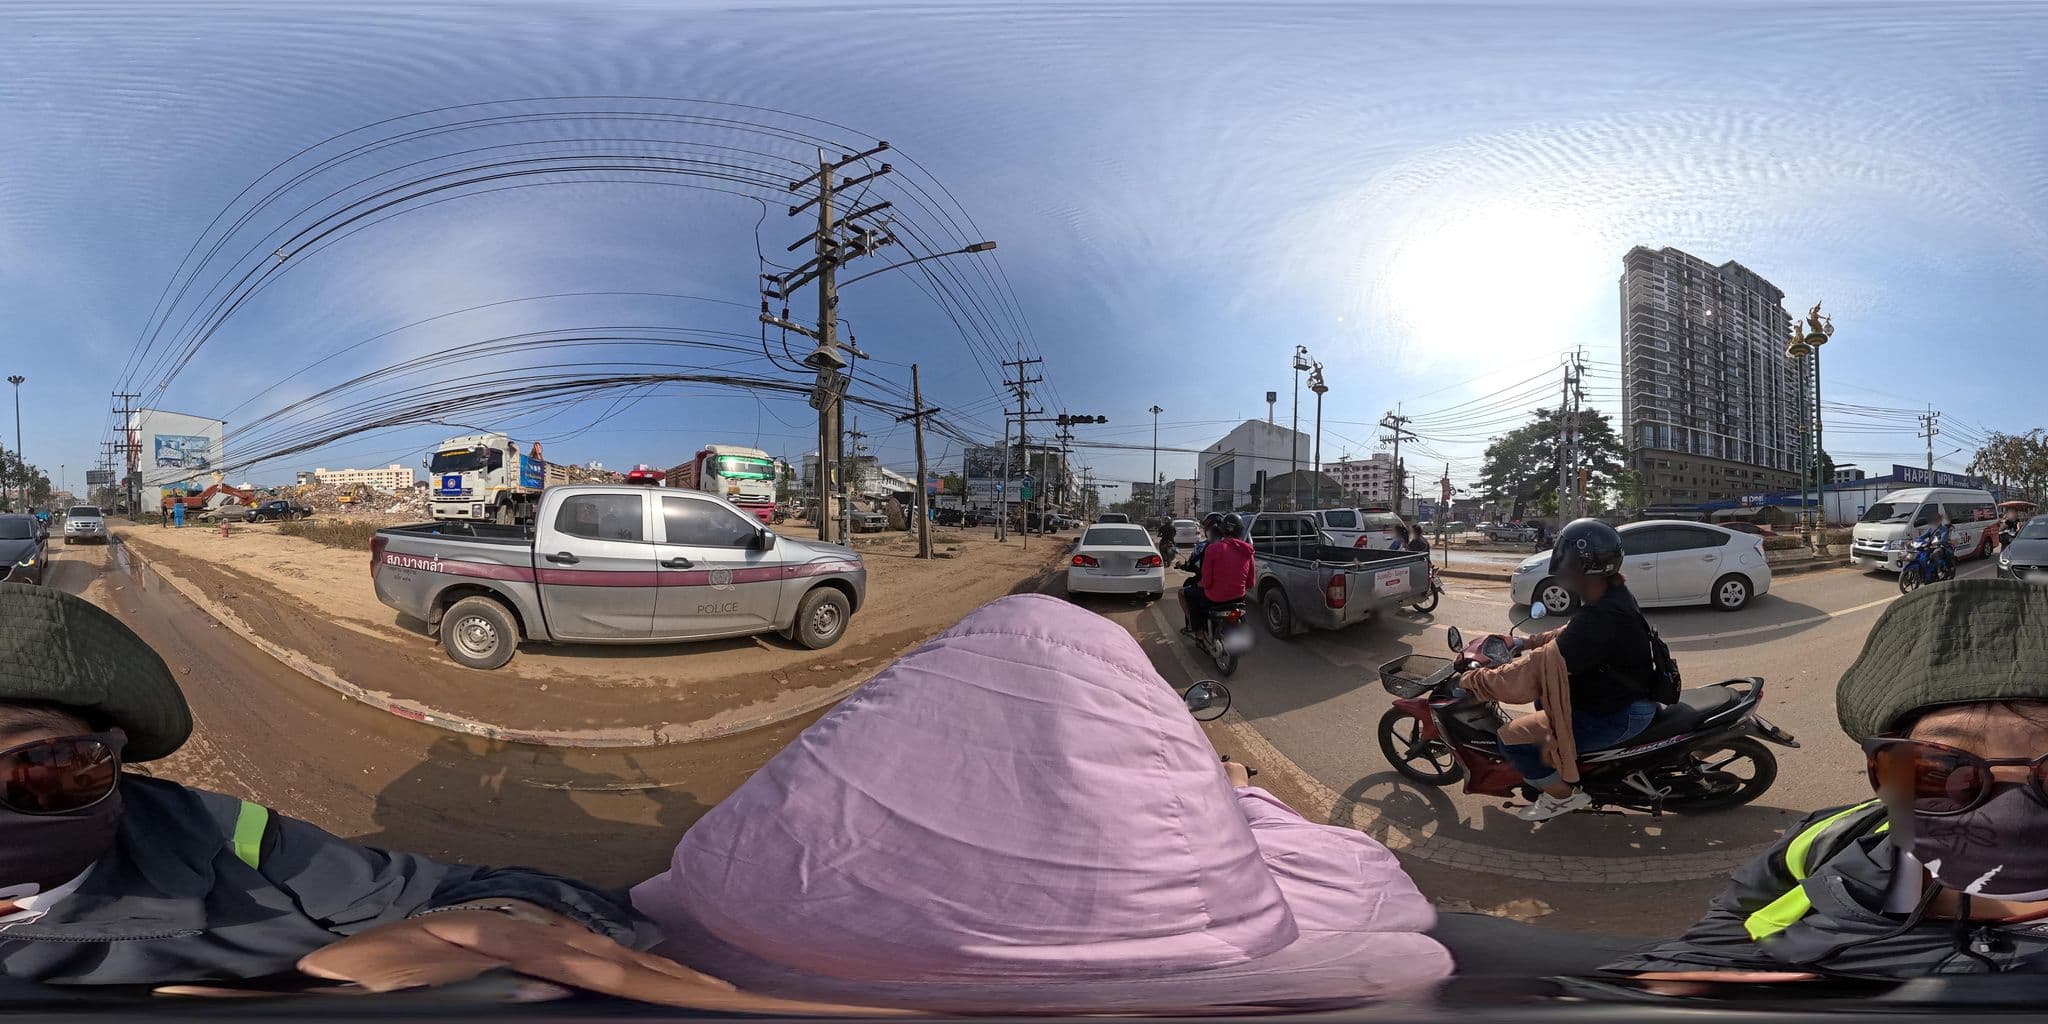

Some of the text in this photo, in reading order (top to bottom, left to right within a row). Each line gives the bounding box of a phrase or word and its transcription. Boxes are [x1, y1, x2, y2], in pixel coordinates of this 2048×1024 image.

[1937, 473, 1954, 486] MPM
[386, 553, 444, 573] สภ.บางกล่ำ
[697, 601, 738, 614] POLICE
